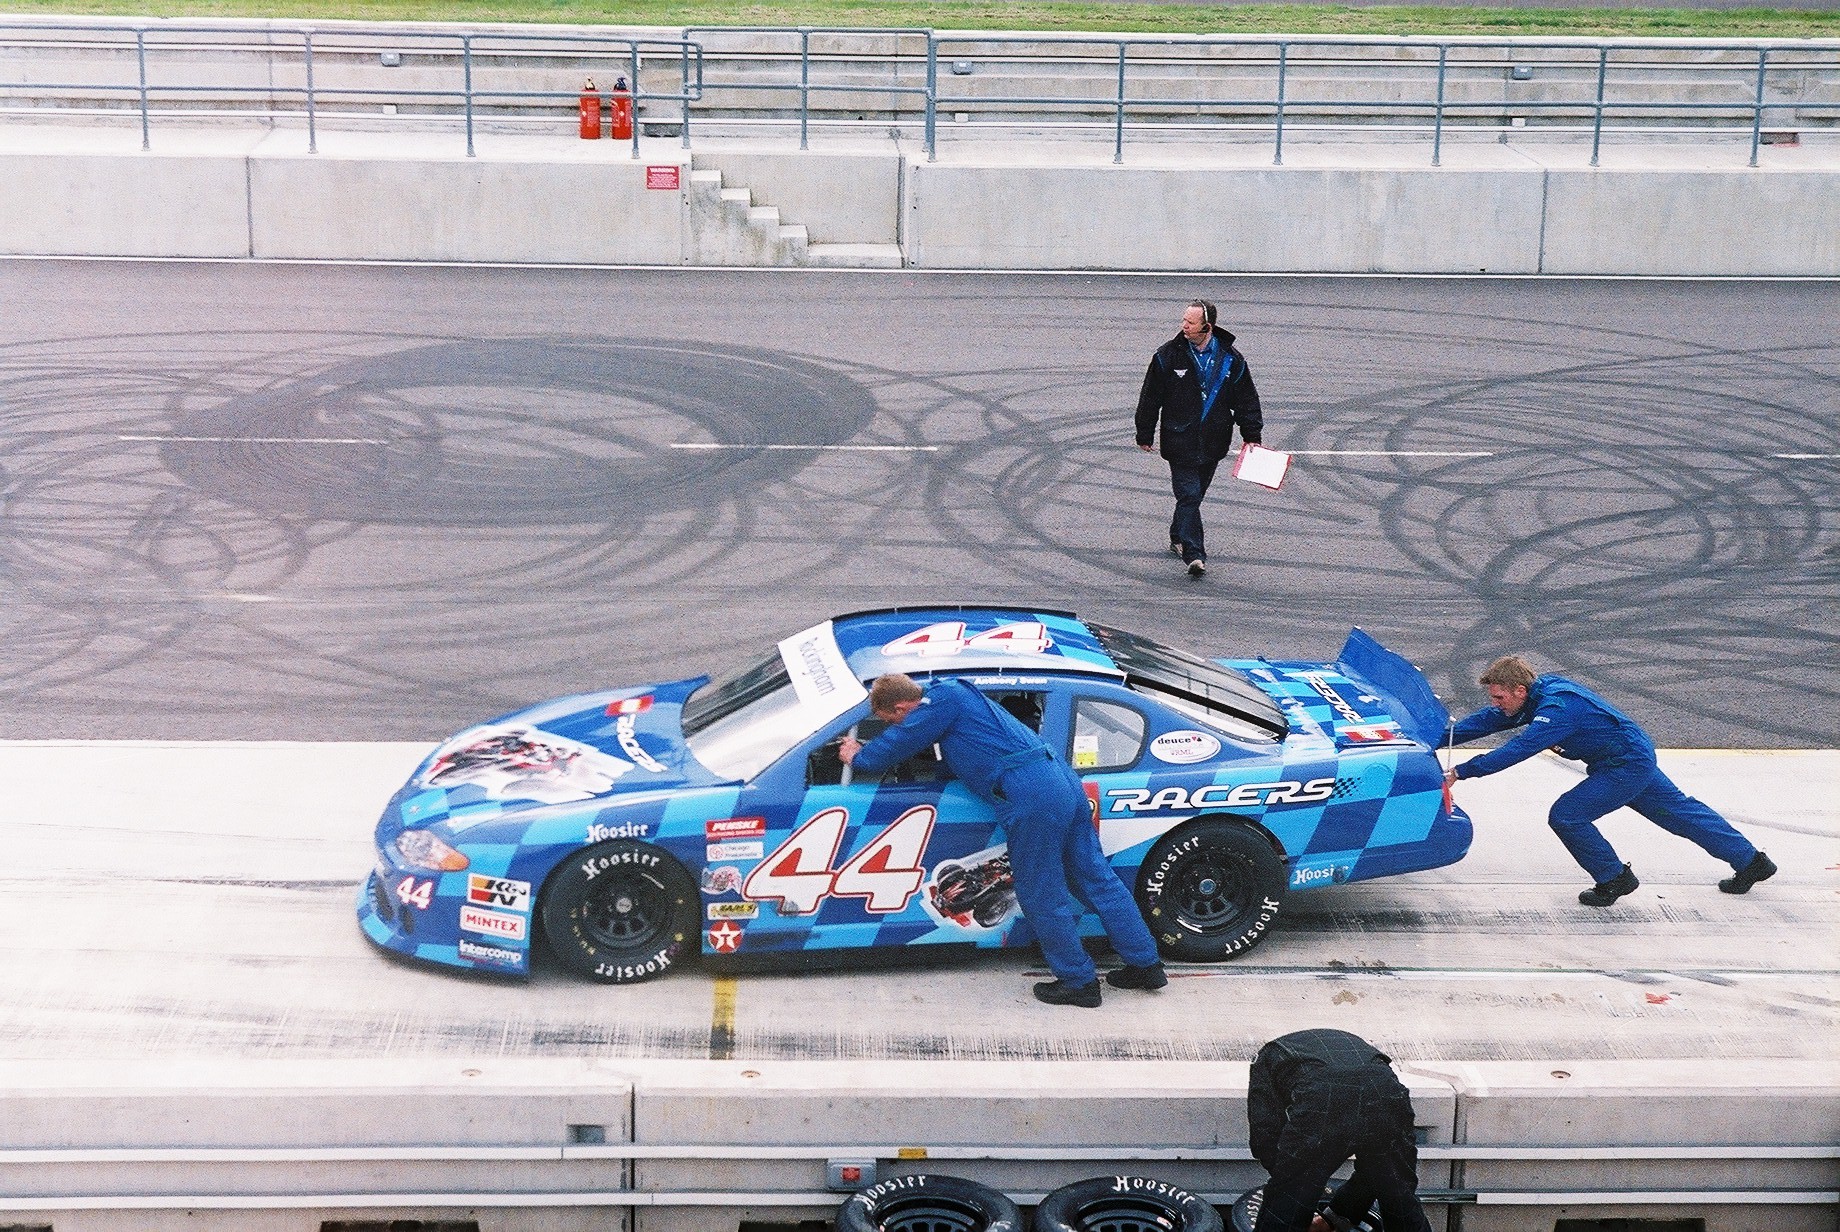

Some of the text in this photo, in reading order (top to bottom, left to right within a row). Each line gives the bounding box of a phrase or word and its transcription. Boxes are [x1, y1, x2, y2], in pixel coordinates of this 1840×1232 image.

[881, 621, 1053, 657] 44
[1157, 737, 1191, 745] deuce
[1106, 776, 1336, 812] RACERS
[585, 821, 649, 843] Hoosier
[581, 849, 660, 881] Hoosier
[741, 804, 936, 917] 44
[1146, 836, 1200, 896] Hoosier
[396, 874, 435, 911] 44
[465, 913, 518, 933] MINTEX
[1225, 897, 1280, 955] Hoosier
[459, 939, 522, 964] Intercomp
[594, 949, 672, 982] Hoosier
[852, 1175, 926, 1212] Hoosier
[1112, 1175, 1196, 1206] Hoosier
